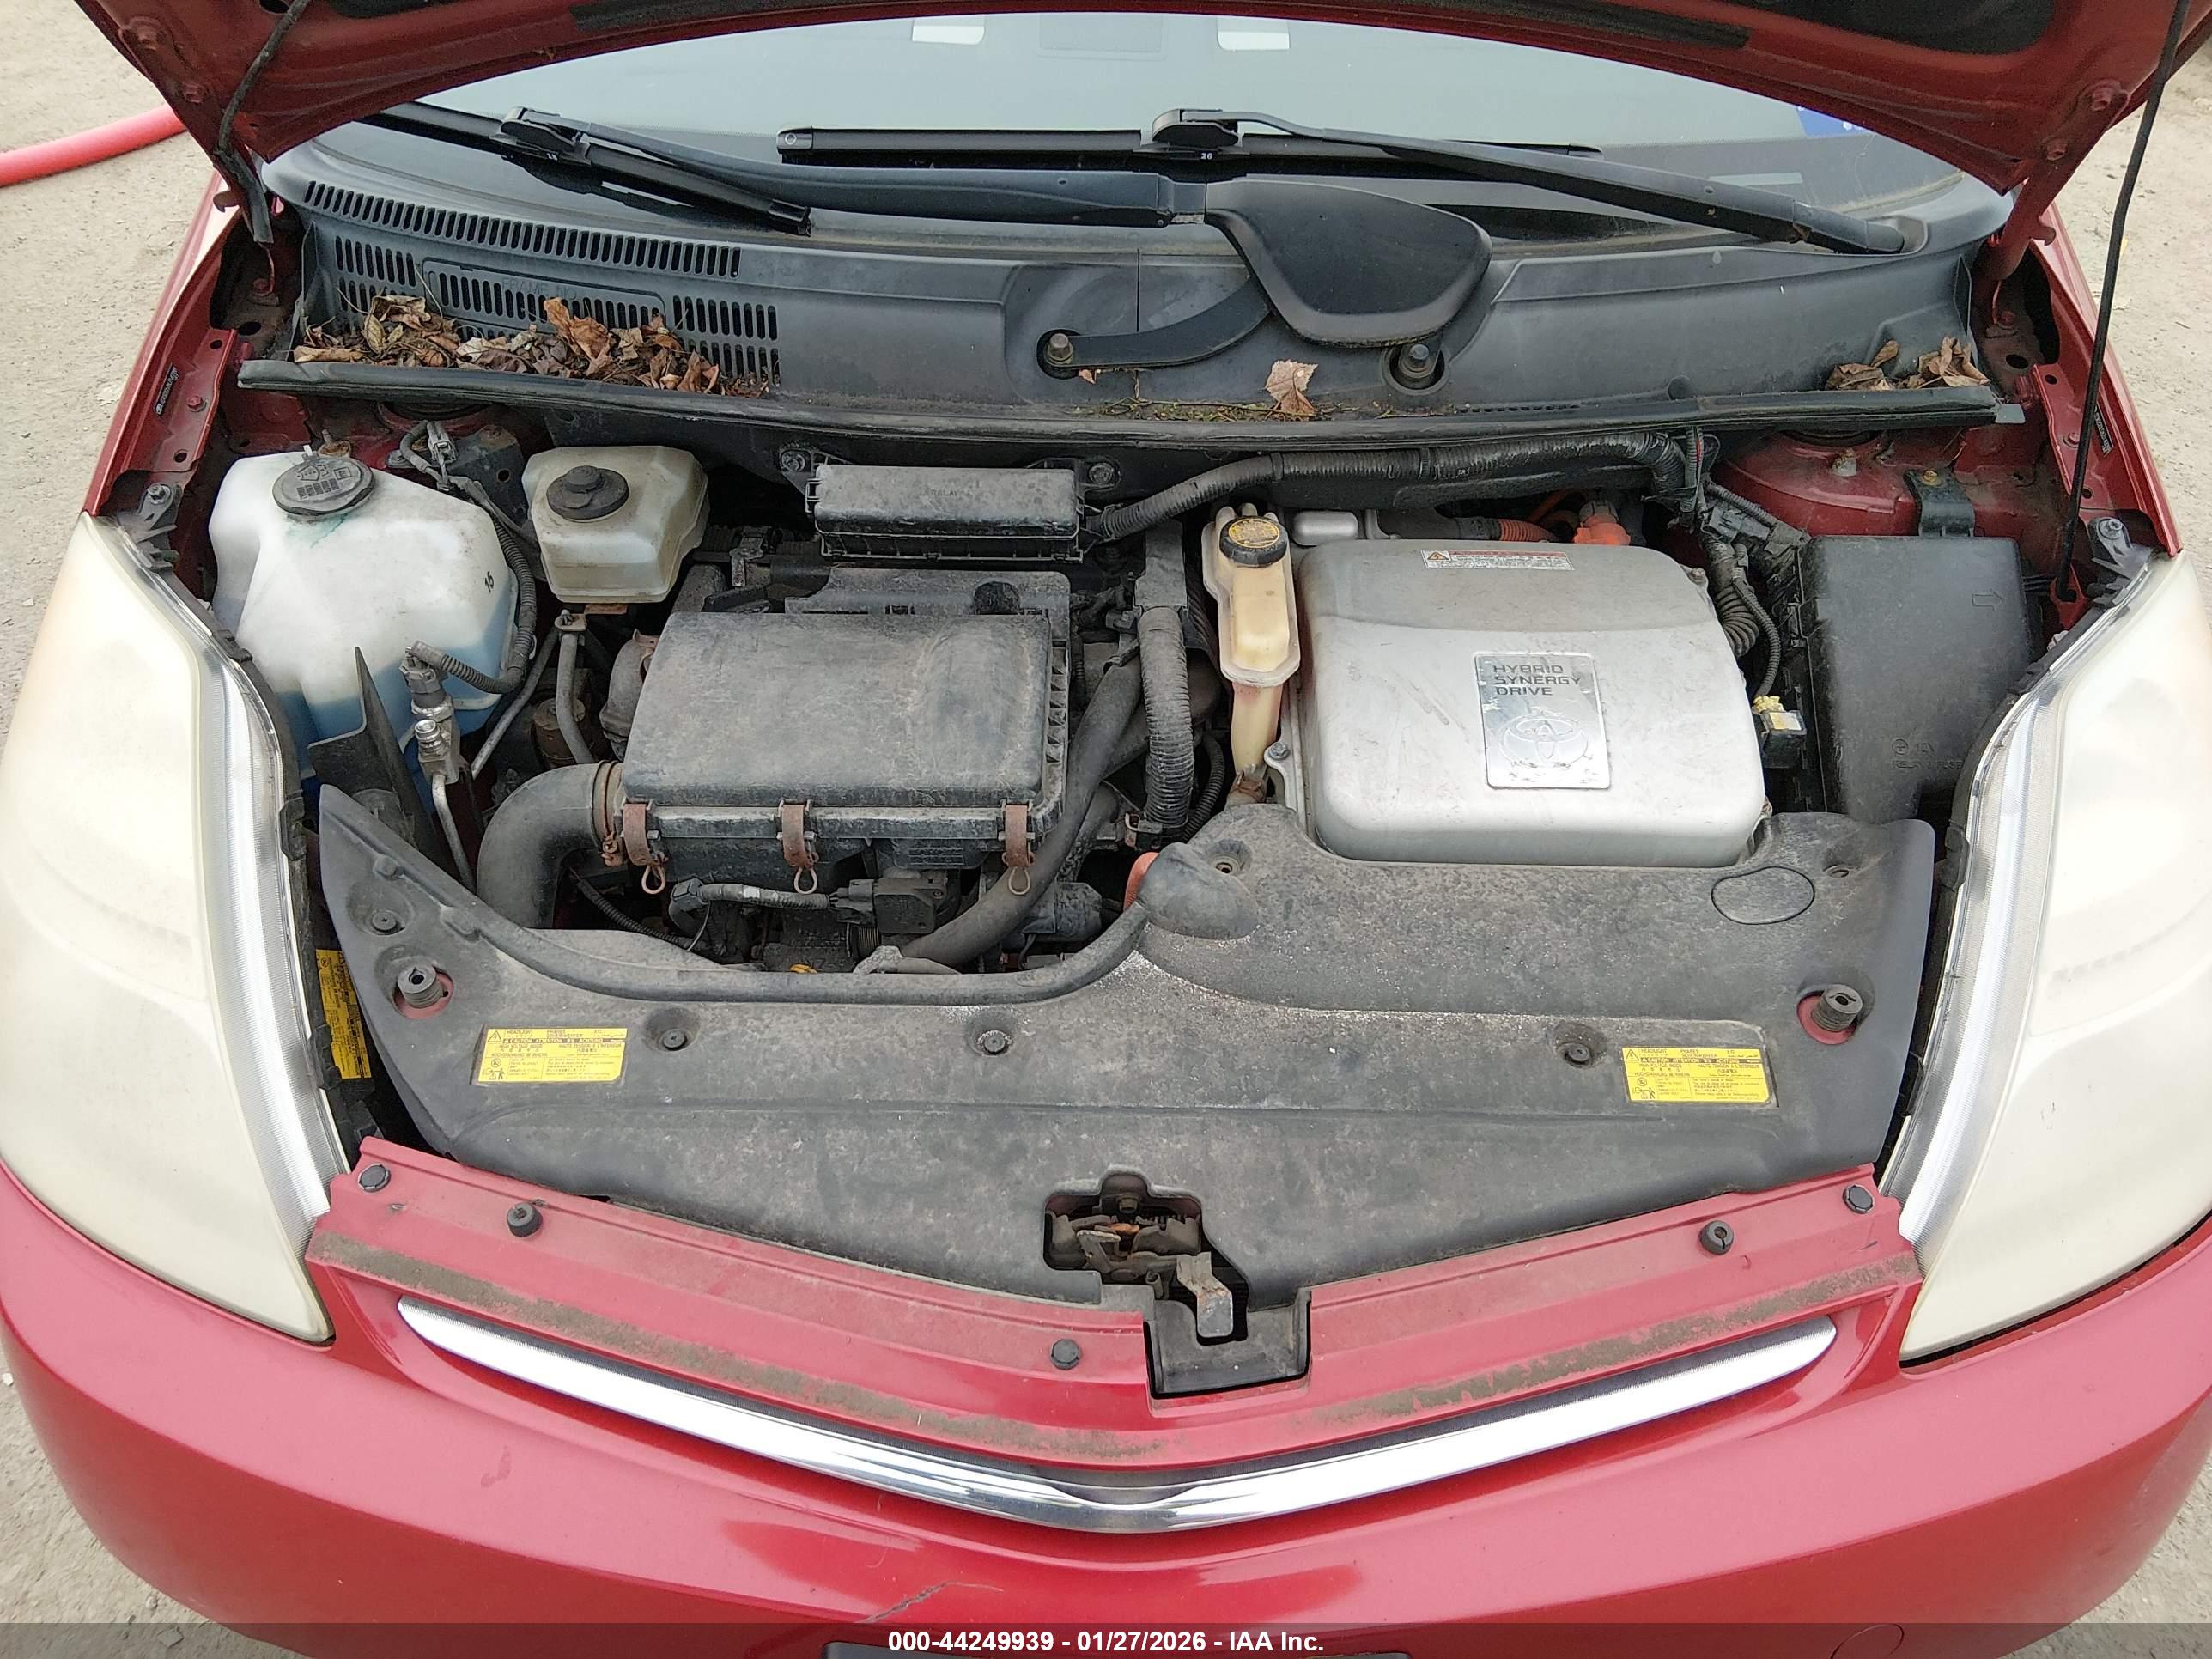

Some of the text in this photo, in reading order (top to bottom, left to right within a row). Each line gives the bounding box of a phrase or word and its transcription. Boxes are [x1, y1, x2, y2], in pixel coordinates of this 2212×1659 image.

[1493, 665, 1564, 674] HYBRID
[1495, 675, 1582, 685] SYNERGY
[1496, 686, 1553, 696] DRIVE
